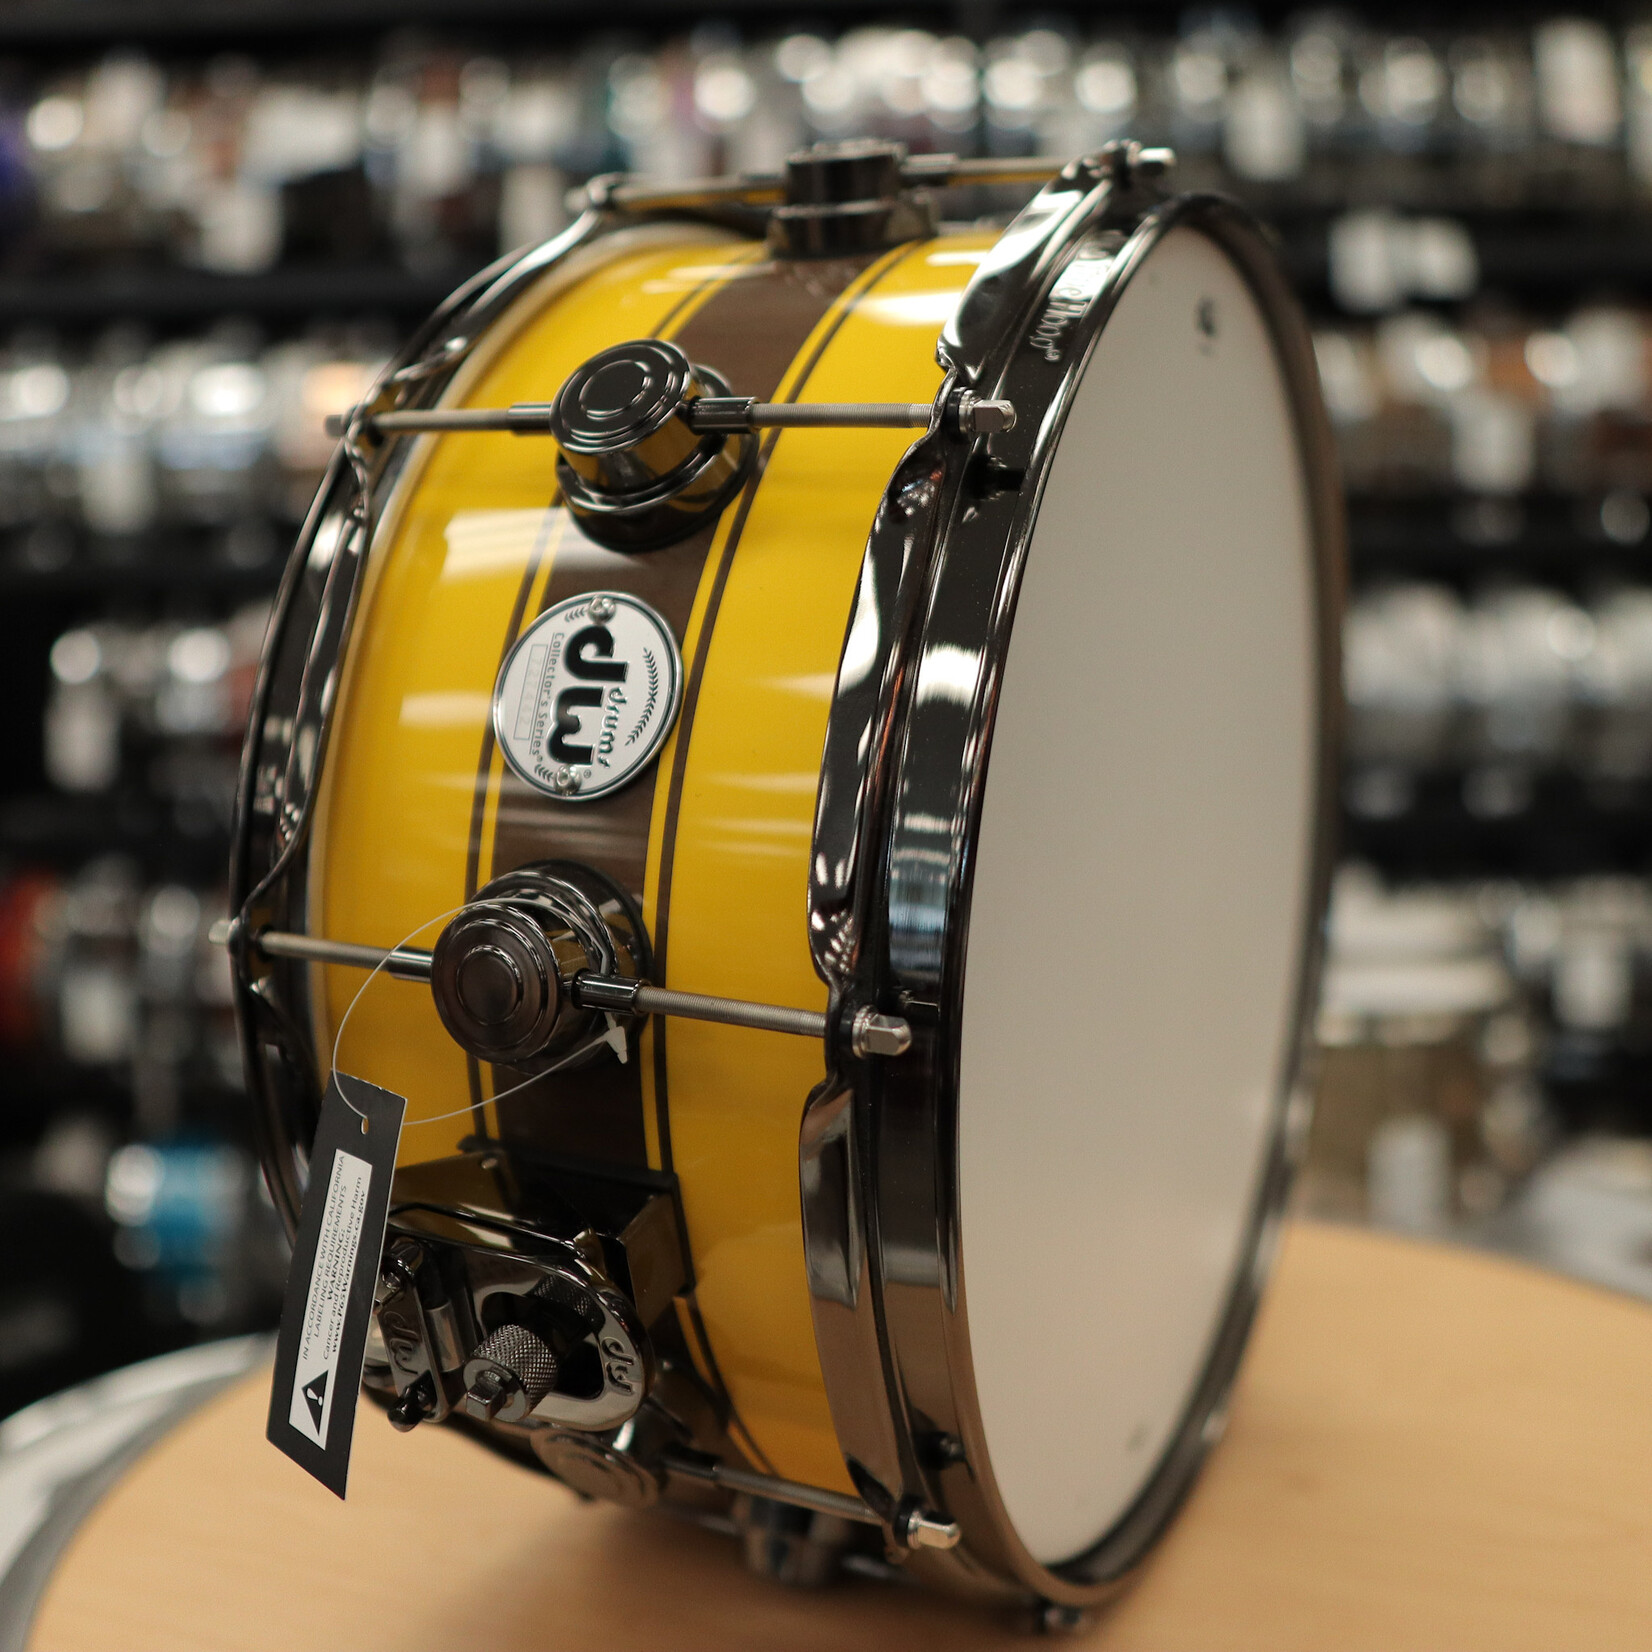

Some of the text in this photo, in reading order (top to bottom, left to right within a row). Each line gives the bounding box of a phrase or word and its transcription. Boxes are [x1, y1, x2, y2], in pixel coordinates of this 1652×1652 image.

[540, 632, 565, 707] Collector's
[598, 687, 628, 768] drums
[302, 1156, 344, 1360] IN ACCORDANCE WITH CALIFORNIA
[314, 1185, 347, 1338] LABELING REQUIREMENTS
[323, 1319, 334, 1360] Cancer
[335, 1211, 355, 1291] Reproductive
[351, 1177, 362, 1209] Harm
[327, 1229, 345, 1300] WARNING:
[332, 1191, 365, 1353] www.P65Warnings.ca.gov
